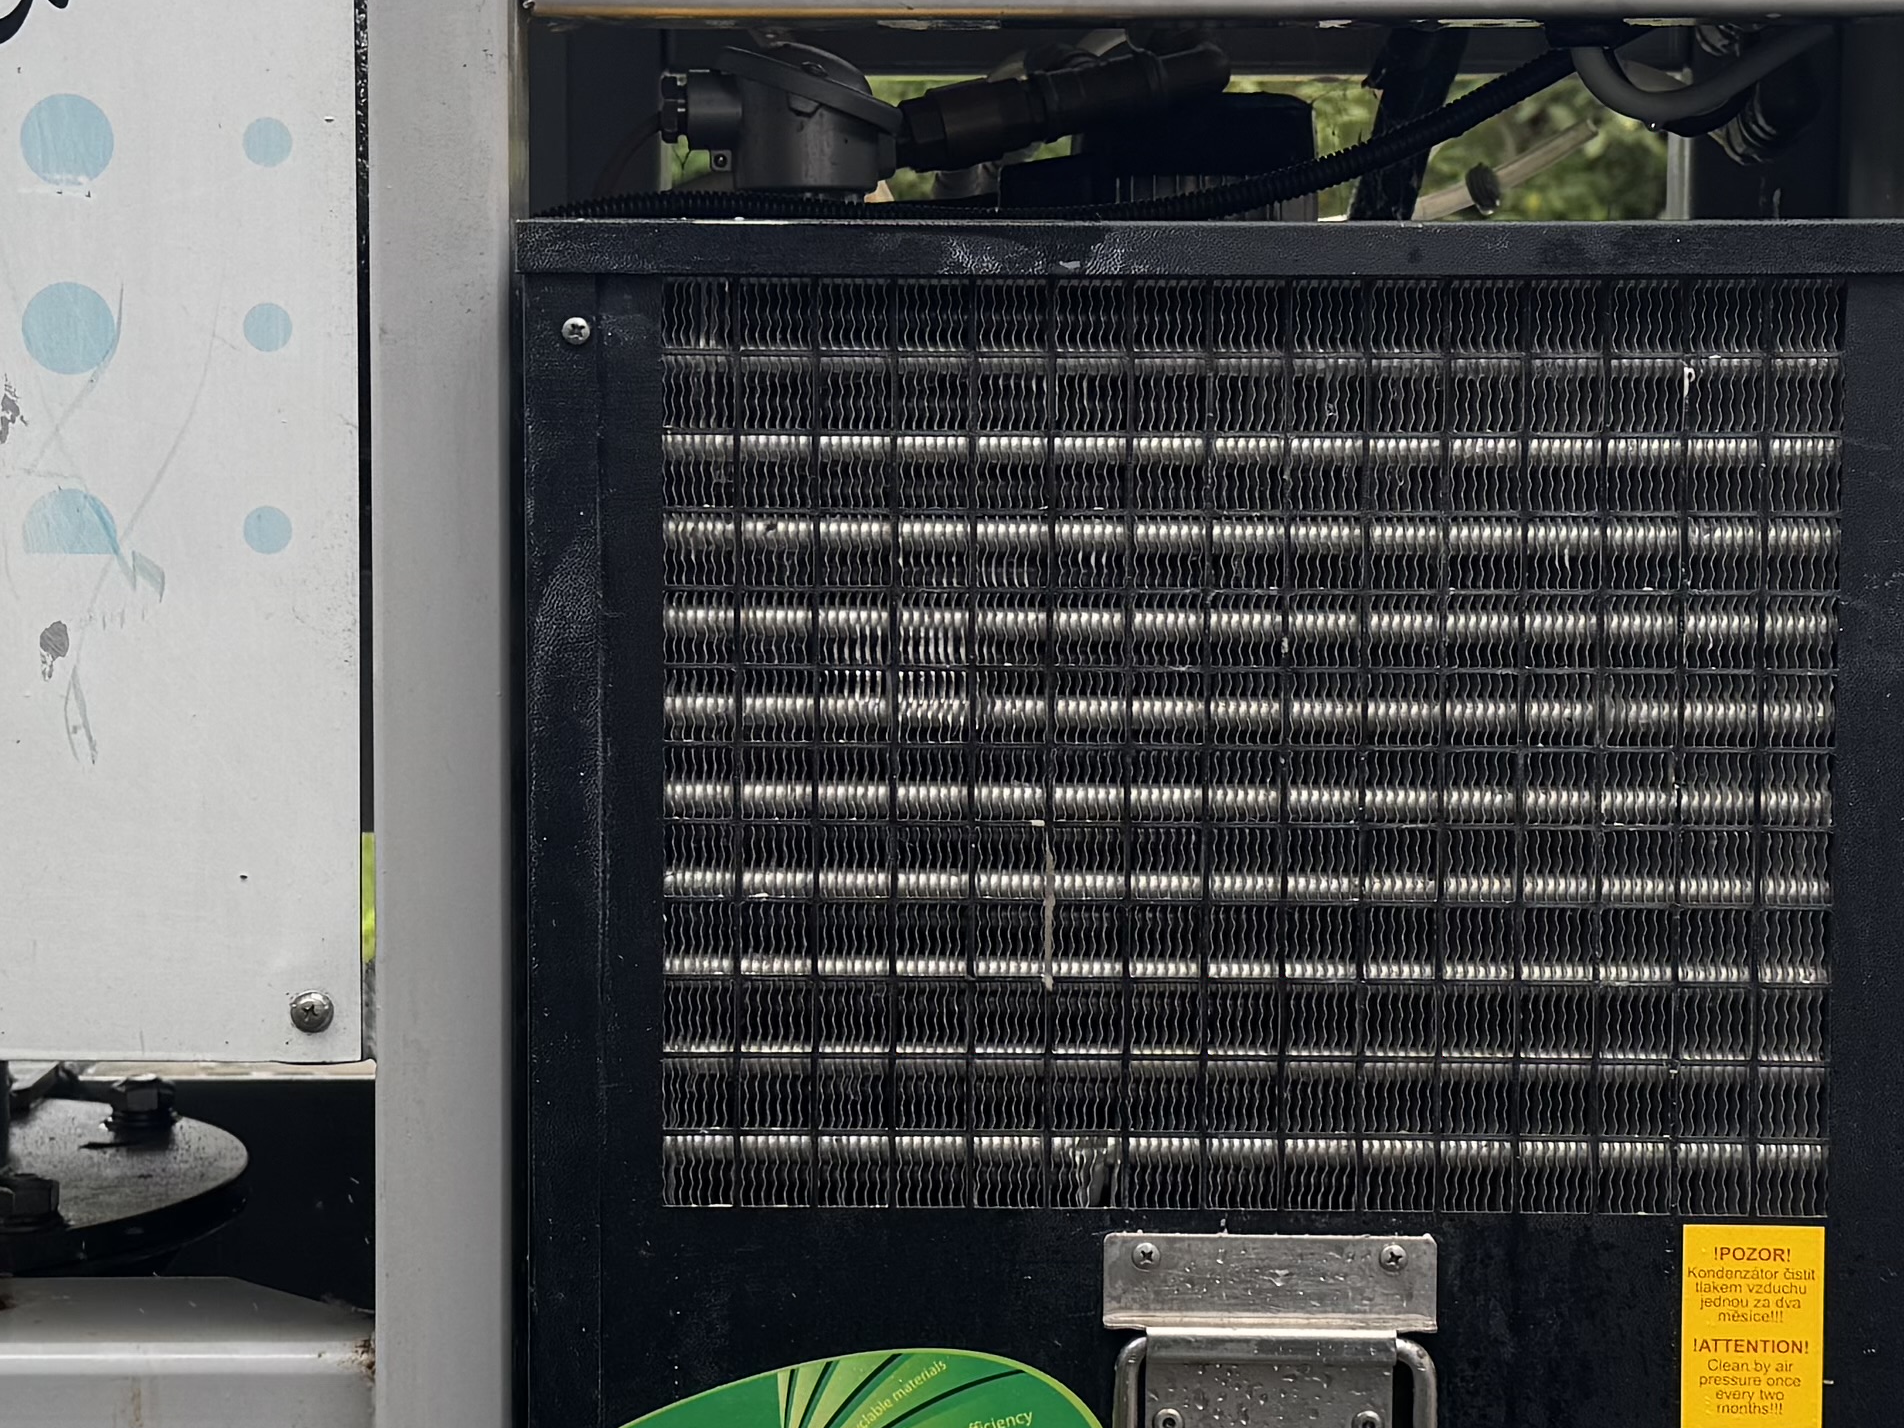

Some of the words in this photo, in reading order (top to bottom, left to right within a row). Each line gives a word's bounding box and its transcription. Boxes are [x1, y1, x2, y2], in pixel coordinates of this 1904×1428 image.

[1714, 1246, 1792, 1263] !POZOR!
[1687, 1266, 1780, 1281] Kondenzátor
[1695, 1281, 1743, 1294] tlakem
[1748, 1282, 1807, 1295] vzduchu
[1699, 1296, 1749, 1311] jednou
[1753, 1298, 1772, 1309] za
[1776, 1296, 1802, 1309] dva
[1693, 1339, 1809, 1355] !ATTENTION!
[1707, 1358, 1750, 1372] Clean
[1754, 1359, 1771, 1376] by
[1775, 1360, 1794, 1373] air
[892, 1360, 948, 1403] materials
[1699, 1375, 1762, 1388] pressure
[1766, 1376, 1802, 1388] once
[1715, 1389, 1755, 1402] every
[1759, 1389, 1786, 1401] two
